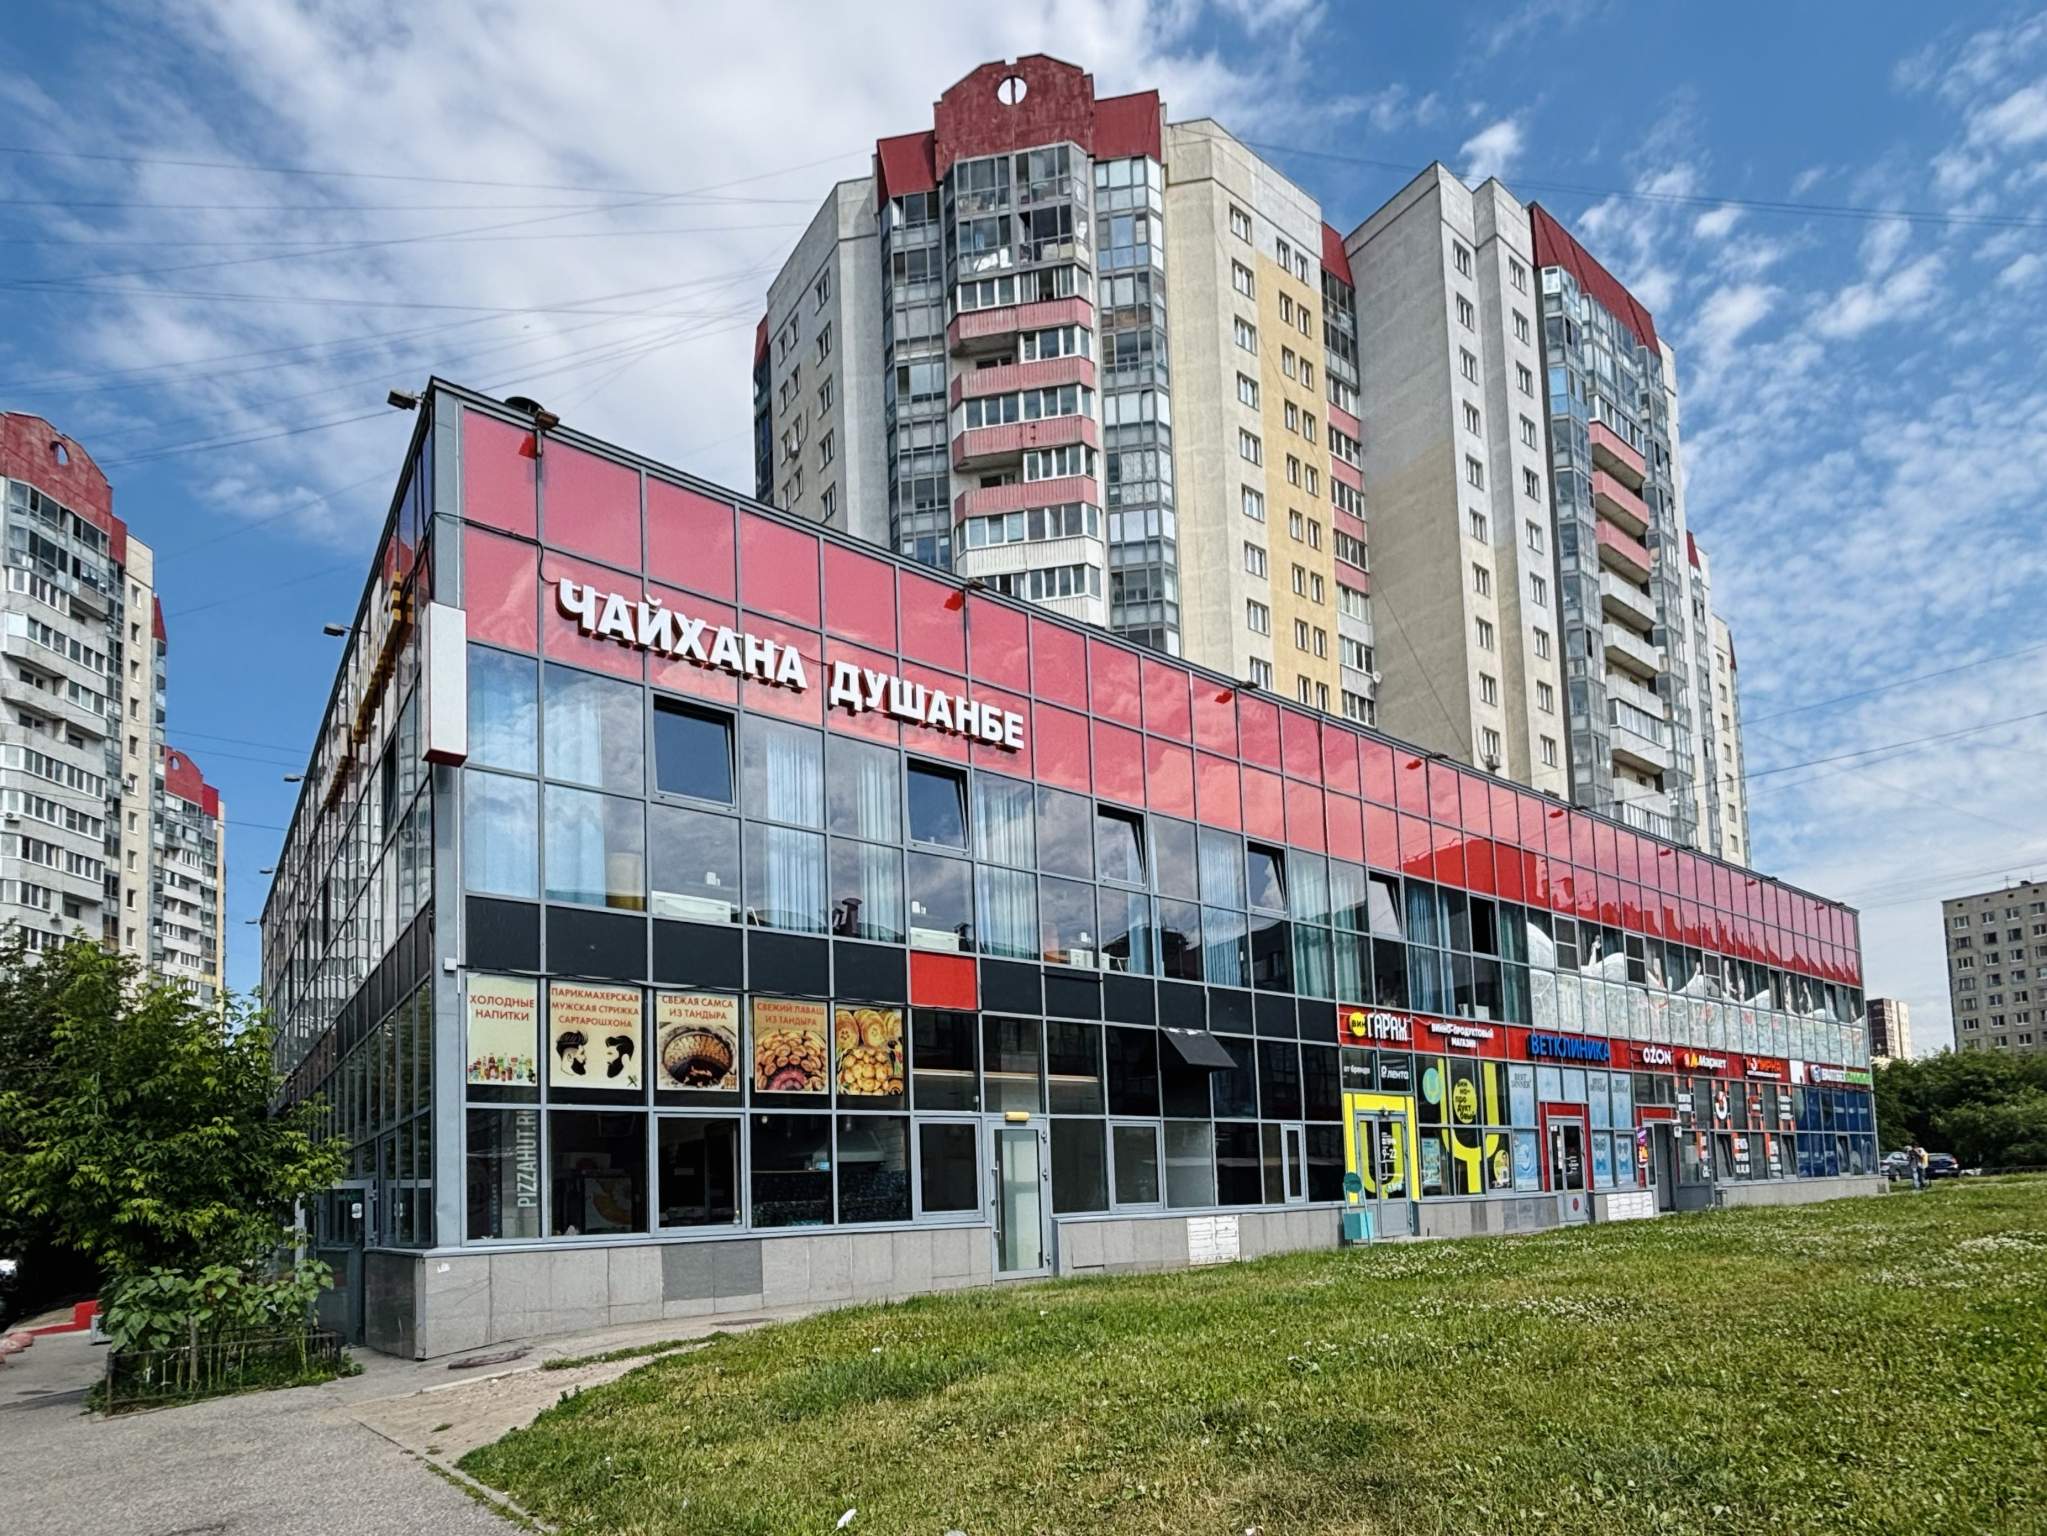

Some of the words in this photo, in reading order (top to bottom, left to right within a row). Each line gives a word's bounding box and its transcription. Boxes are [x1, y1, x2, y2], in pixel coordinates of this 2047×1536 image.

[557, 577, 808, 691] ЧАЙХАНА
[829, 659, 1025, 750] ДУШАНБЕ
[551, 987, 639, 1002] ПАРИКМАХЕРСКАЯ
[470, 994, 535, 1009] ХОЛОДНЫЕ
[662, 995, 700, 1006] СВЕЖАЯ
[701, 998, 734, 1009] САМСА
[475, 1009, 530, 1021] НАПИТКИ
[551, 1002, 598, 1013] МУЖСКАЯ
[598, 1005, 639, 1015] СТРИЖКА
[669, 1009, 683, 1017] ИЗ
[685, 1010, 727, 1020] ТАНДЫРА
[757, 1002, 793, 1012] СВЕЖИЙ
[794, 1004, 825, 1015] ЛАВАШ
[559, 1015, 633, 1027] САРТАРОШХОНА
[765, 1015, 778, 1024] ИЗ
[779, 1017, 817, 1026] ТАНДЫРА
[1366, 1013, 1408, 1041] ГАРАЖ
[1451, 1037, 1476, 1048] МАГАЗИН
[1530, 1033, 1610, 1060] ВЕТКЛИНИКА
[1643, 1047, 1672, 1065] OZON
